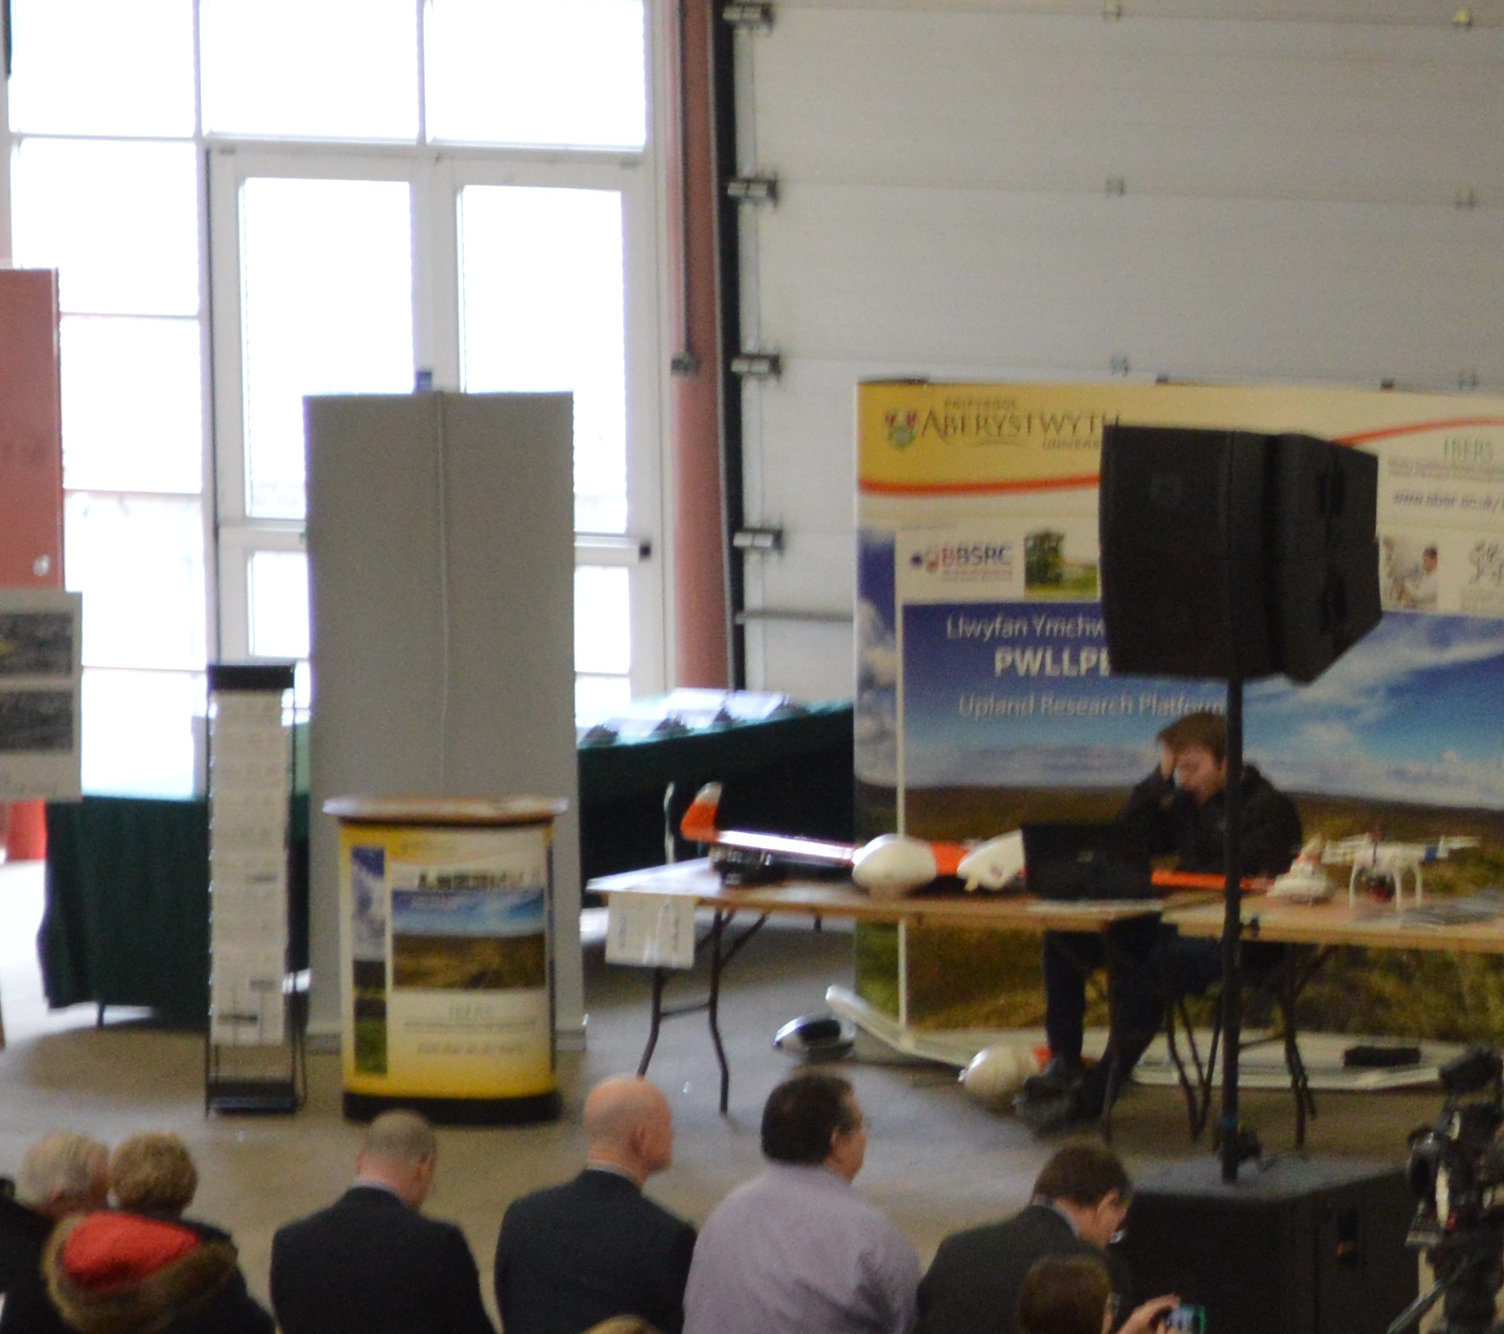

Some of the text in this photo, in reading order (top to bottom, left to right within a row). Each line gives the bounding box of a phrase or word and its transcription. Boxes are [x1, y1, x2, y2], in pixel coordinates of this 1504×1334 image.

[946, 613, 1028, 642] Llwyfan
[958, 691, 1036, 721] Upland
[1041, 692, 1134, 716] Research
